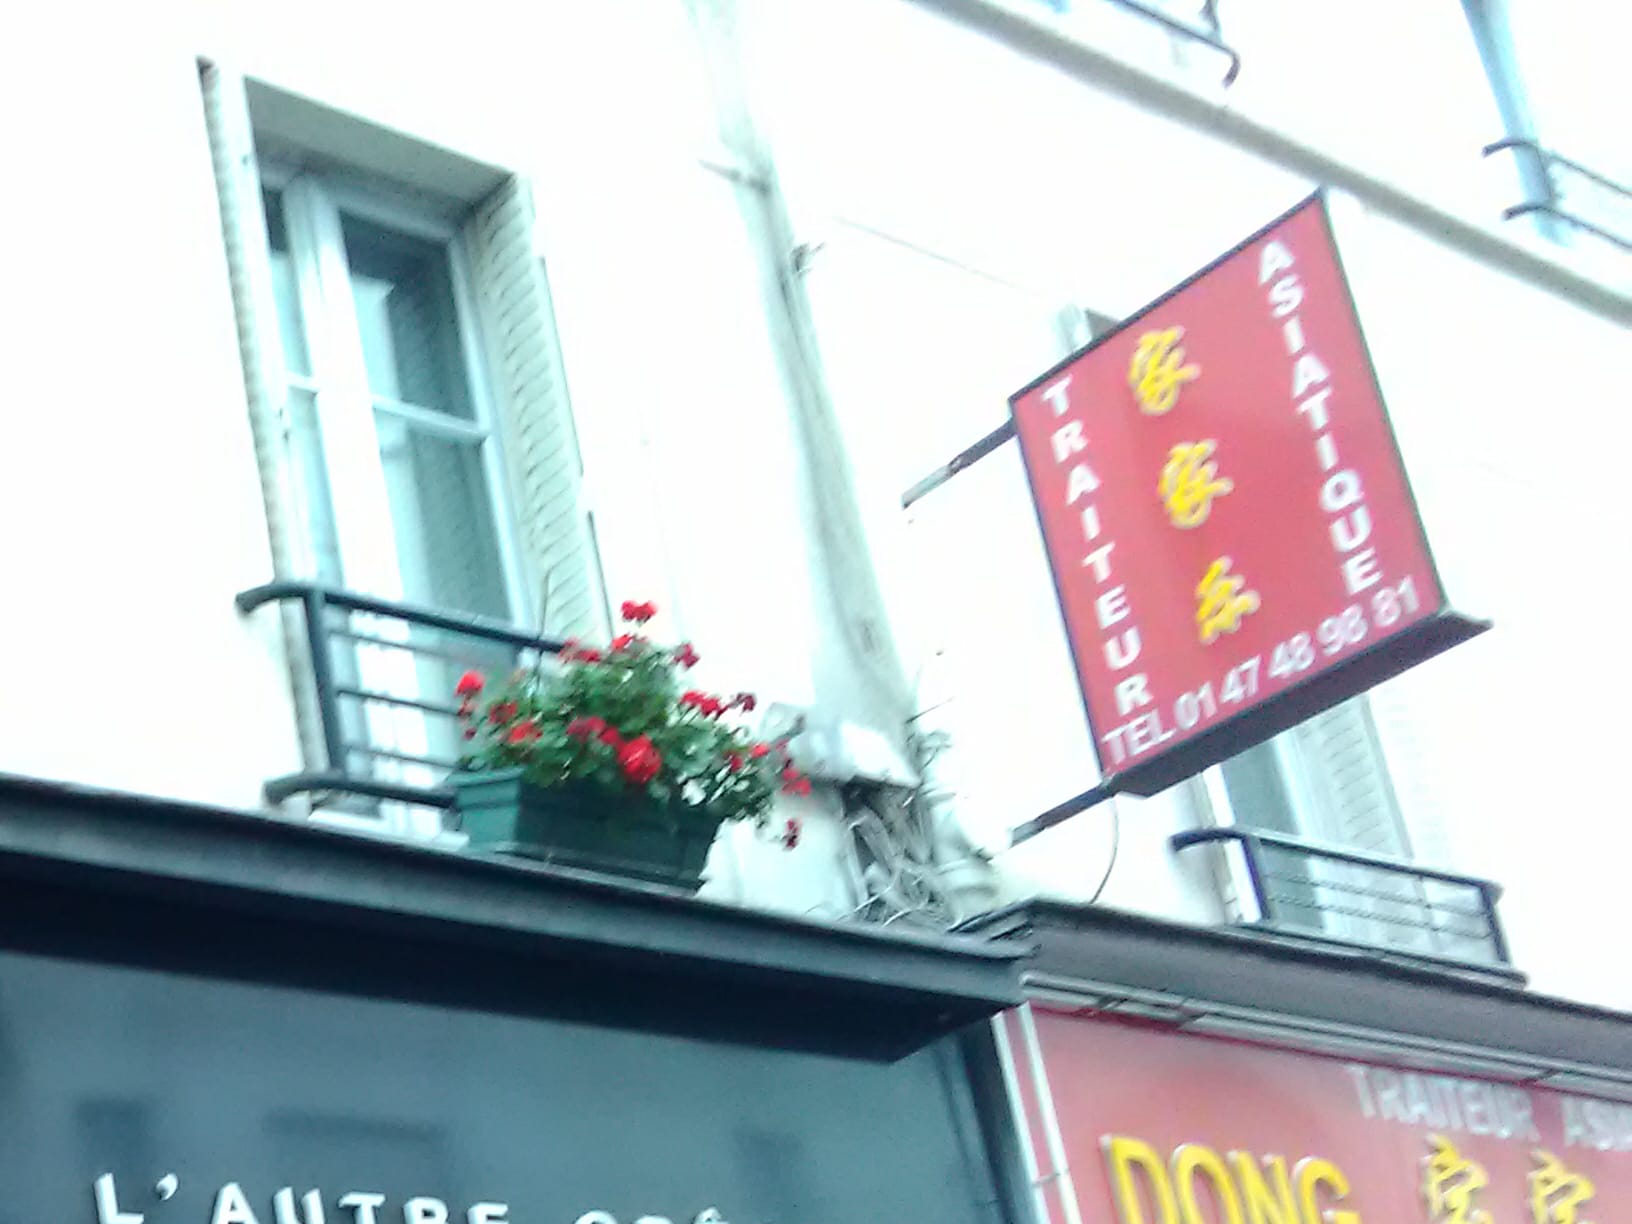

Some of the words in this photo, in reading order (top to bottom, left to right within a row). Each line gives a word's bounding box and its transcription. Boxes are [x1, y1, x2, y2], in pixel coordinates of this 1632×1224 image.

[1258, 240, 1382, 597] ASIATIQUE
[1041, 376, 1154, 716] TRAITEUR
[1173, 681, 1218, 731] 01
[1220, 655, 1261, 704] 47
[1269, 632, 1317, 680] 48
[1318, 603, 1369, 656] 98
[1371, 575, 1419, 628] 81
[1347, 1063, 1541, 1142] TRAITEUR
